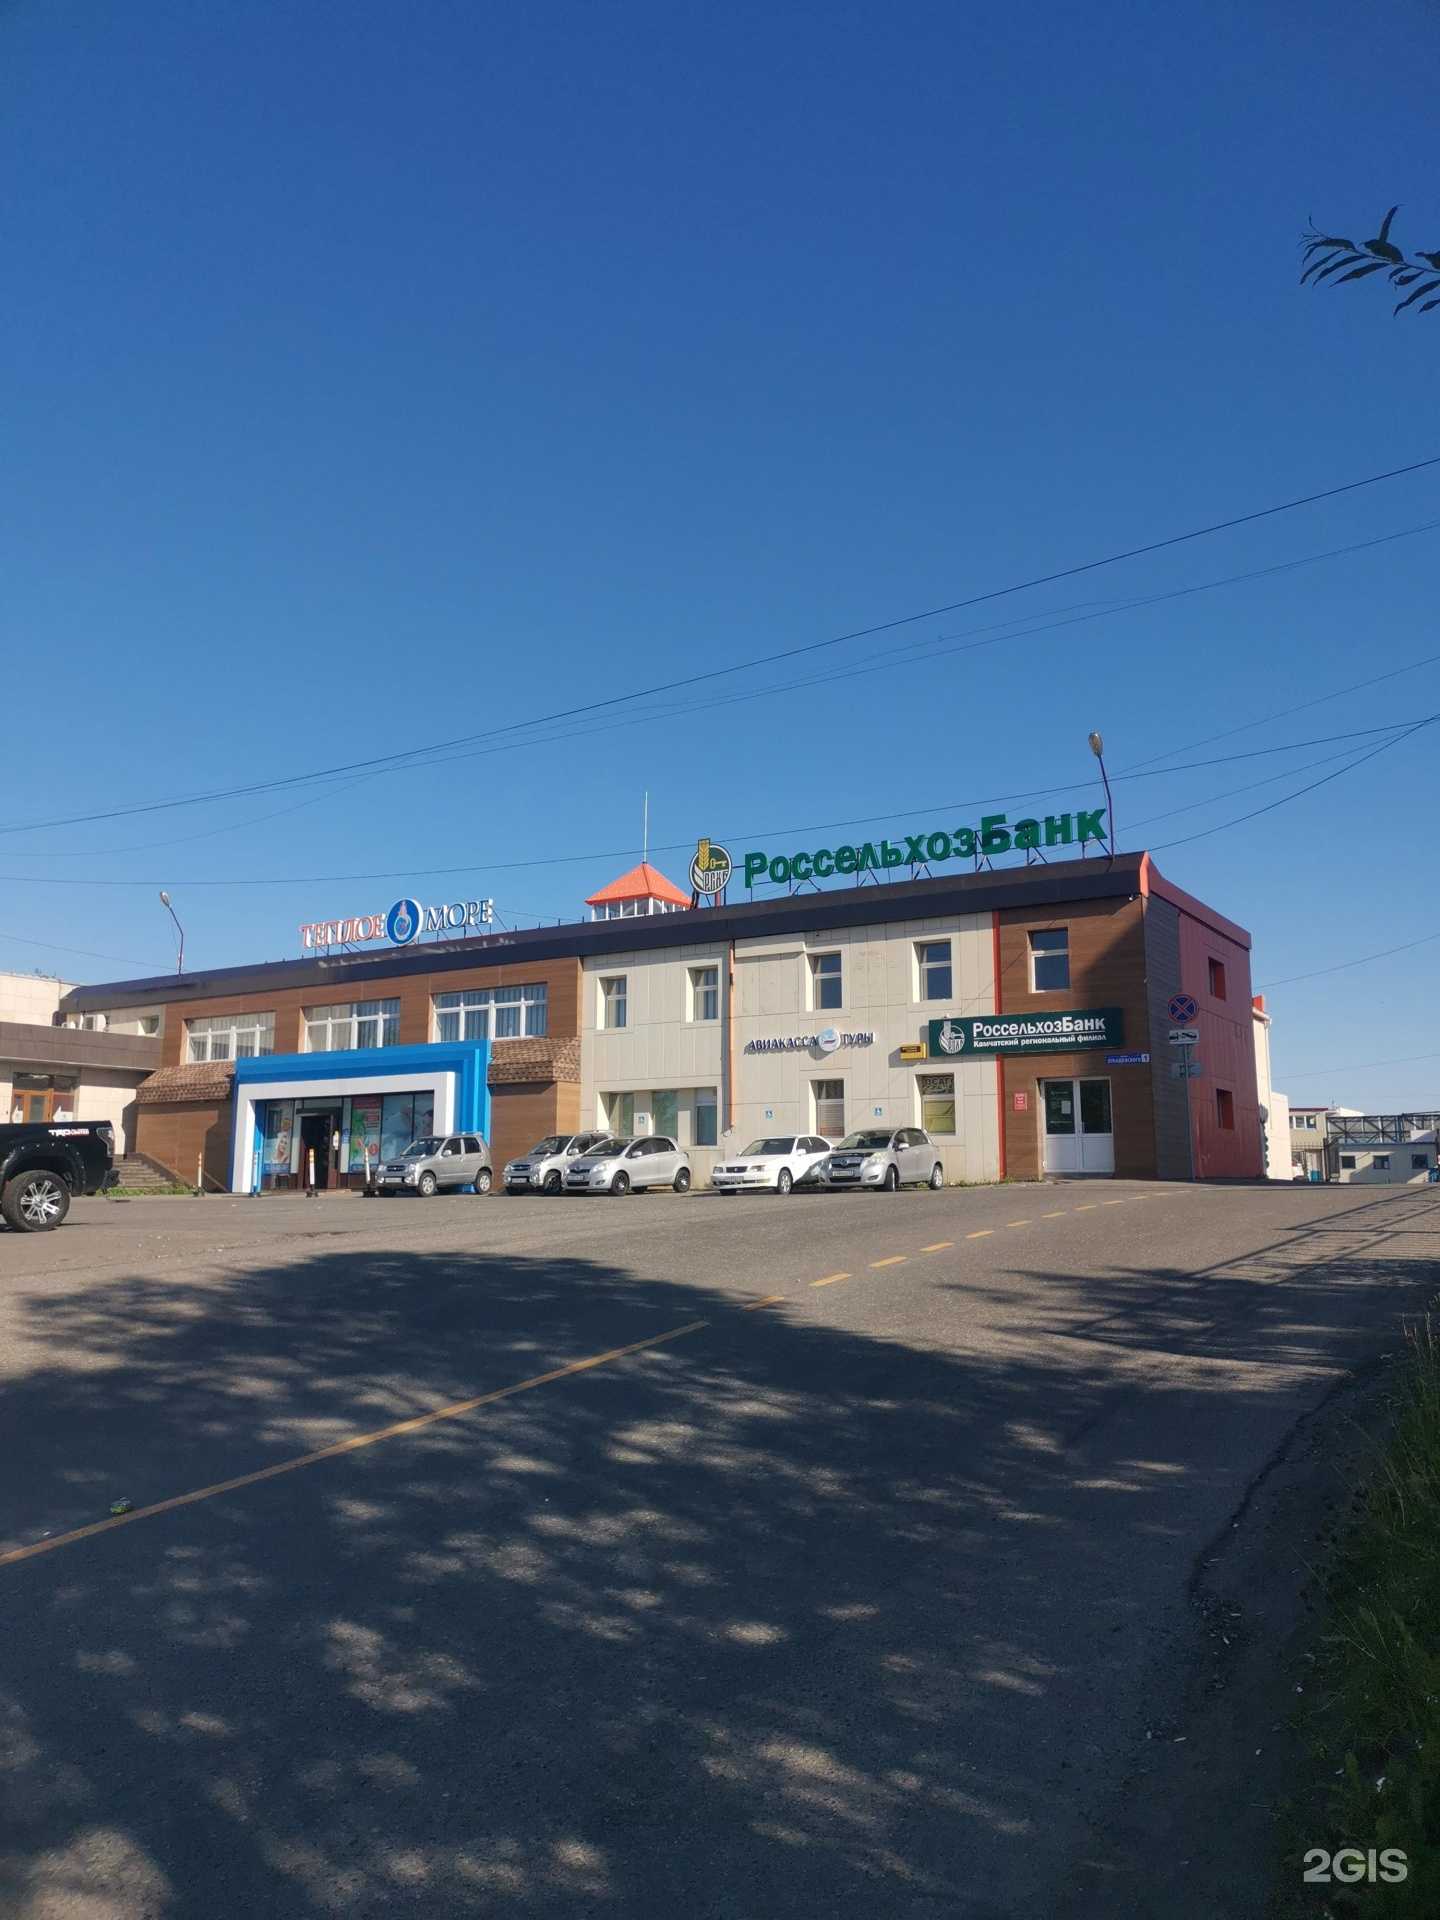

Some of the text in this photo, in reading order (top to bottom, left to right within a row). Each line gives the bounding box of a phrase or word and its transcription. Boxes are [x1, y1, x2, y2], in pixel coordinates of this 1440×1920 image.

[744, 808, 1108, 889] РоссельхозБанк
[299, 898, 494, 948] ТЕПЛОЕ МОРЕ
[972, 1016, 1106, 1038] РоссельхозБанк
[747, 1034, 818, 1051] АВИАКАССА
[973, 1033, 1107, 1048] Камчатский региональный филиал
